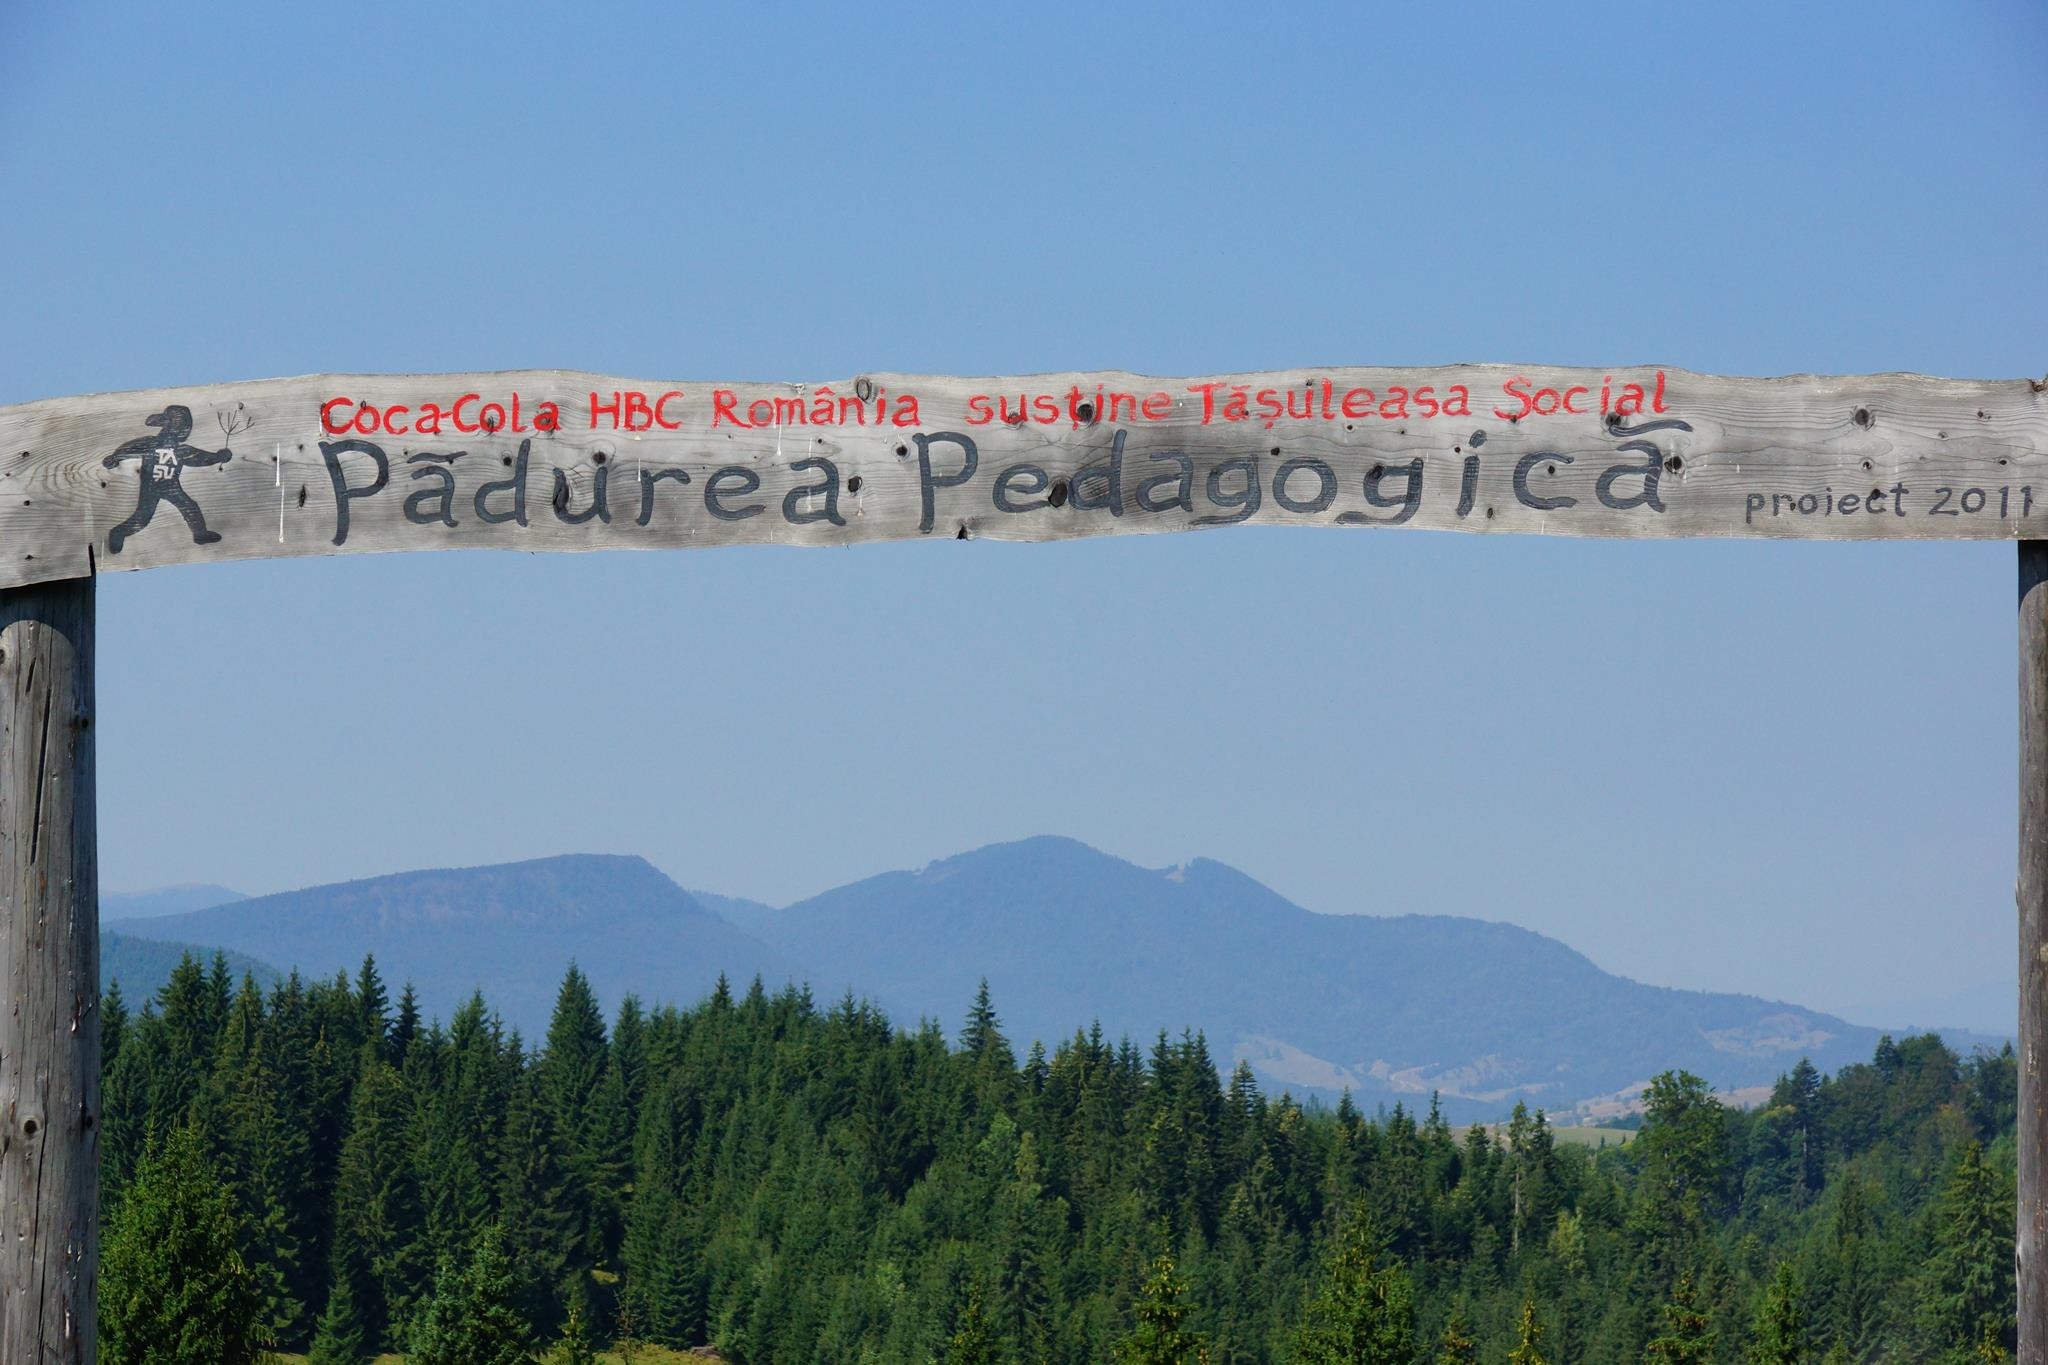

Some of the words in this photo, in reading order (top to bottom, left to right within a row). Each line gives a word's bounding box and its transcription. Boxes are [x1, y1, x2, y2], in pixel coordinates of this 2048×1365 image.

[320, 391, 562, 436] Coca-Cola
[588, 389, 684, 433] HBC
[711, 386, 922, 430] România
[1492, 370, 1672, 421] Social
[1928, 484, 2034, 519] 2011
